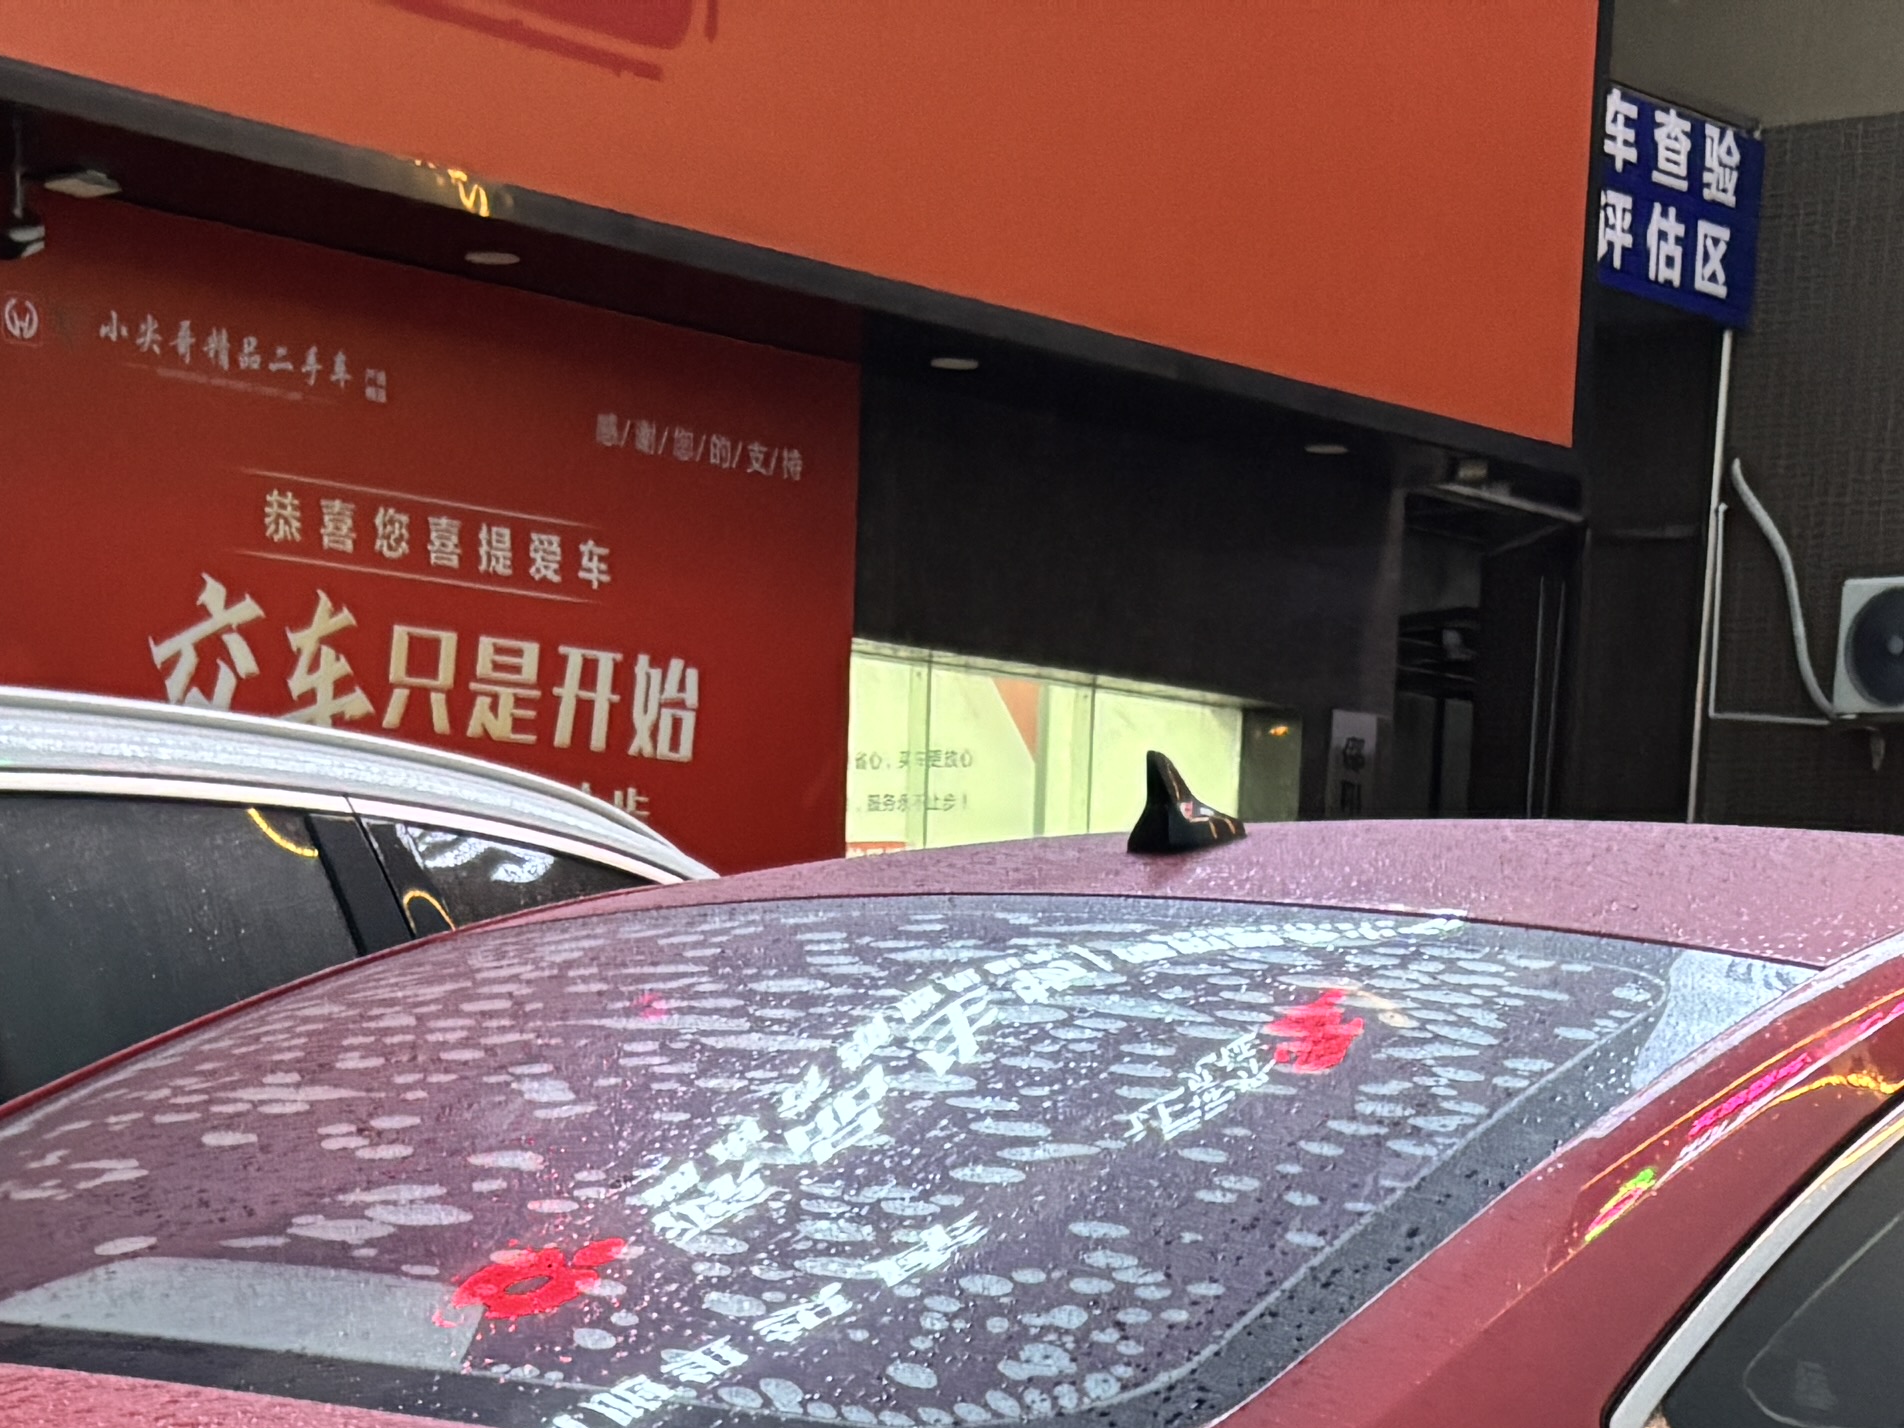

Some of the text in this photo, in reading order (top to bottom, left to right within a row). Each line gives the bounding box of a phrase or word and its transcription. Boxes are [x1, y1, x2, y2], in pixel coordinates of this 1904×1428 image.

[264, 489, 612, 591] 恭喜您喜提爱车
